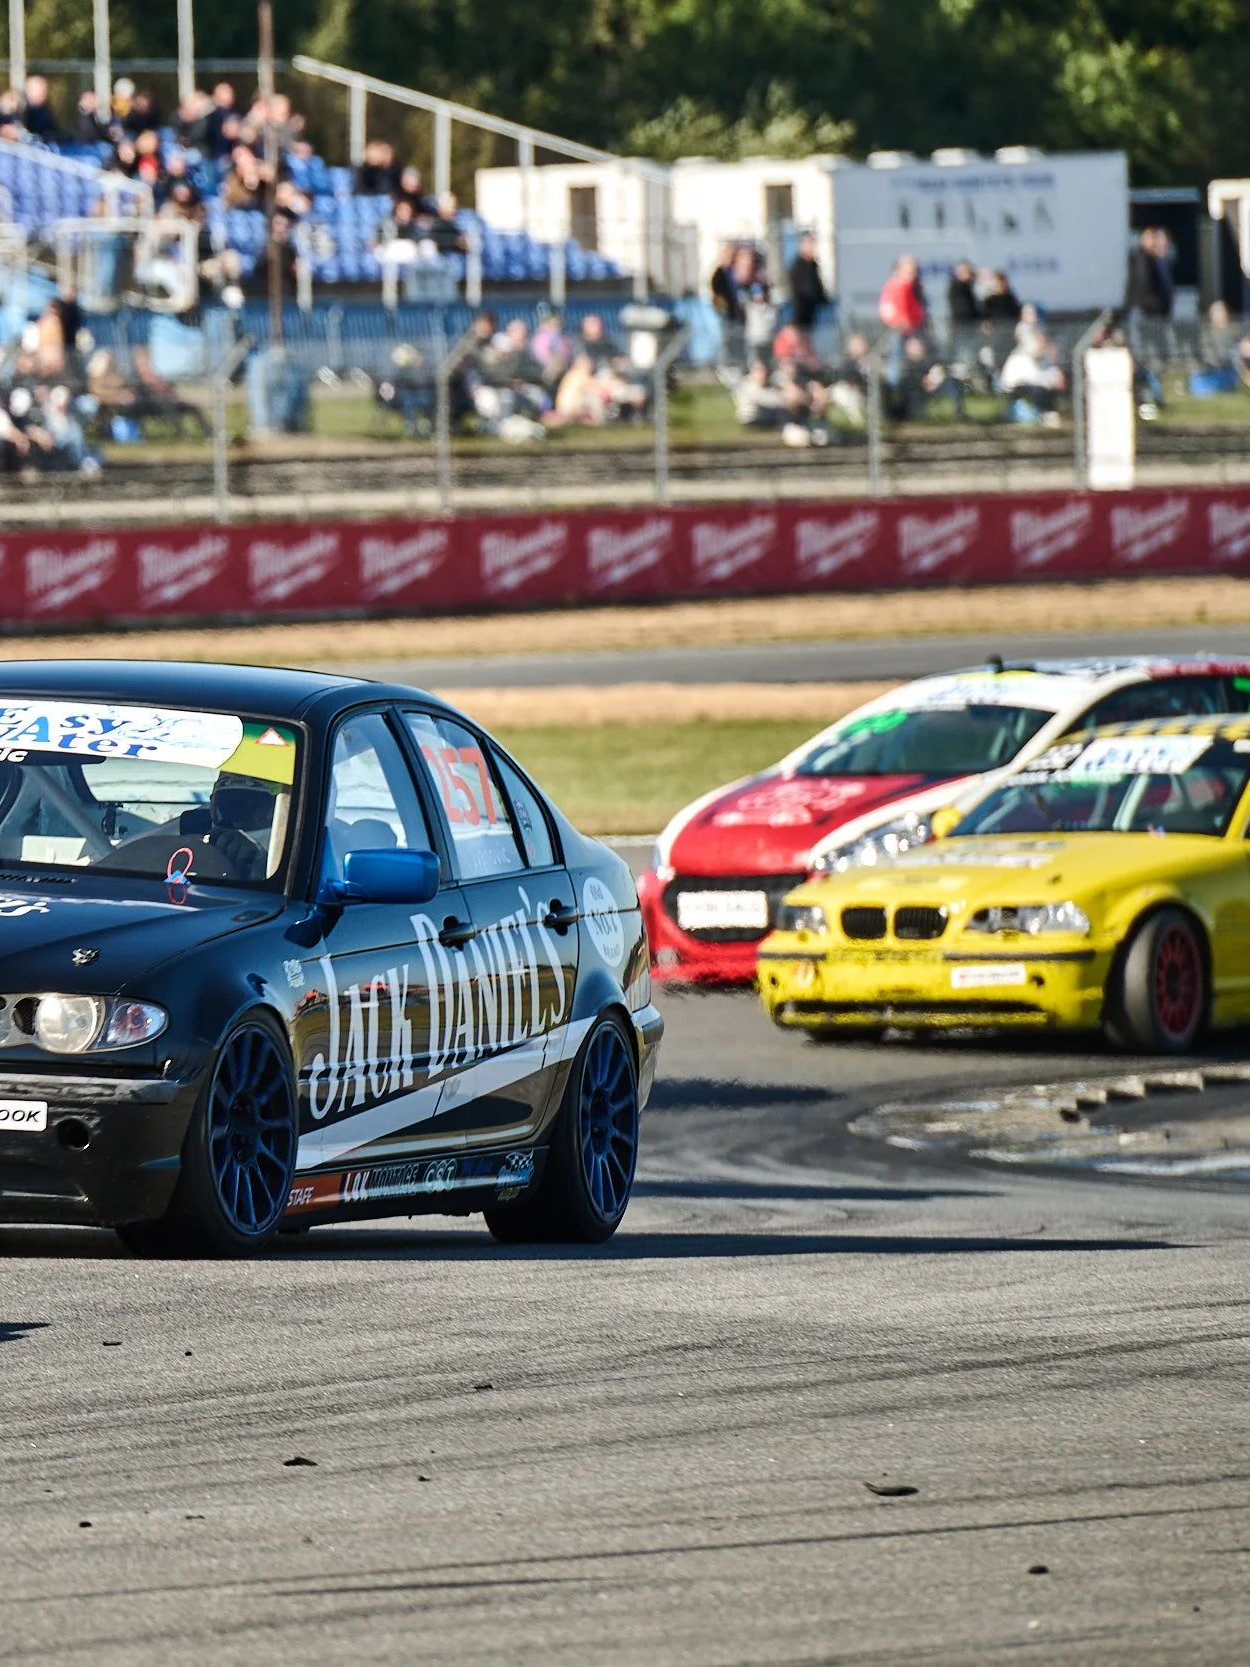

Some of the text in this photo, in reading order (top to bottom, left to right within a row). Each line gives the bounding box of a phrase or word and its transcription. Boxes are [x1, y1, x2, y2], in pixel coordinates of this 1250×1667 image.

[309, 885, 568, 1121] JACK DANIEL'S
[286, 1186, 315, 1207] STAFF
